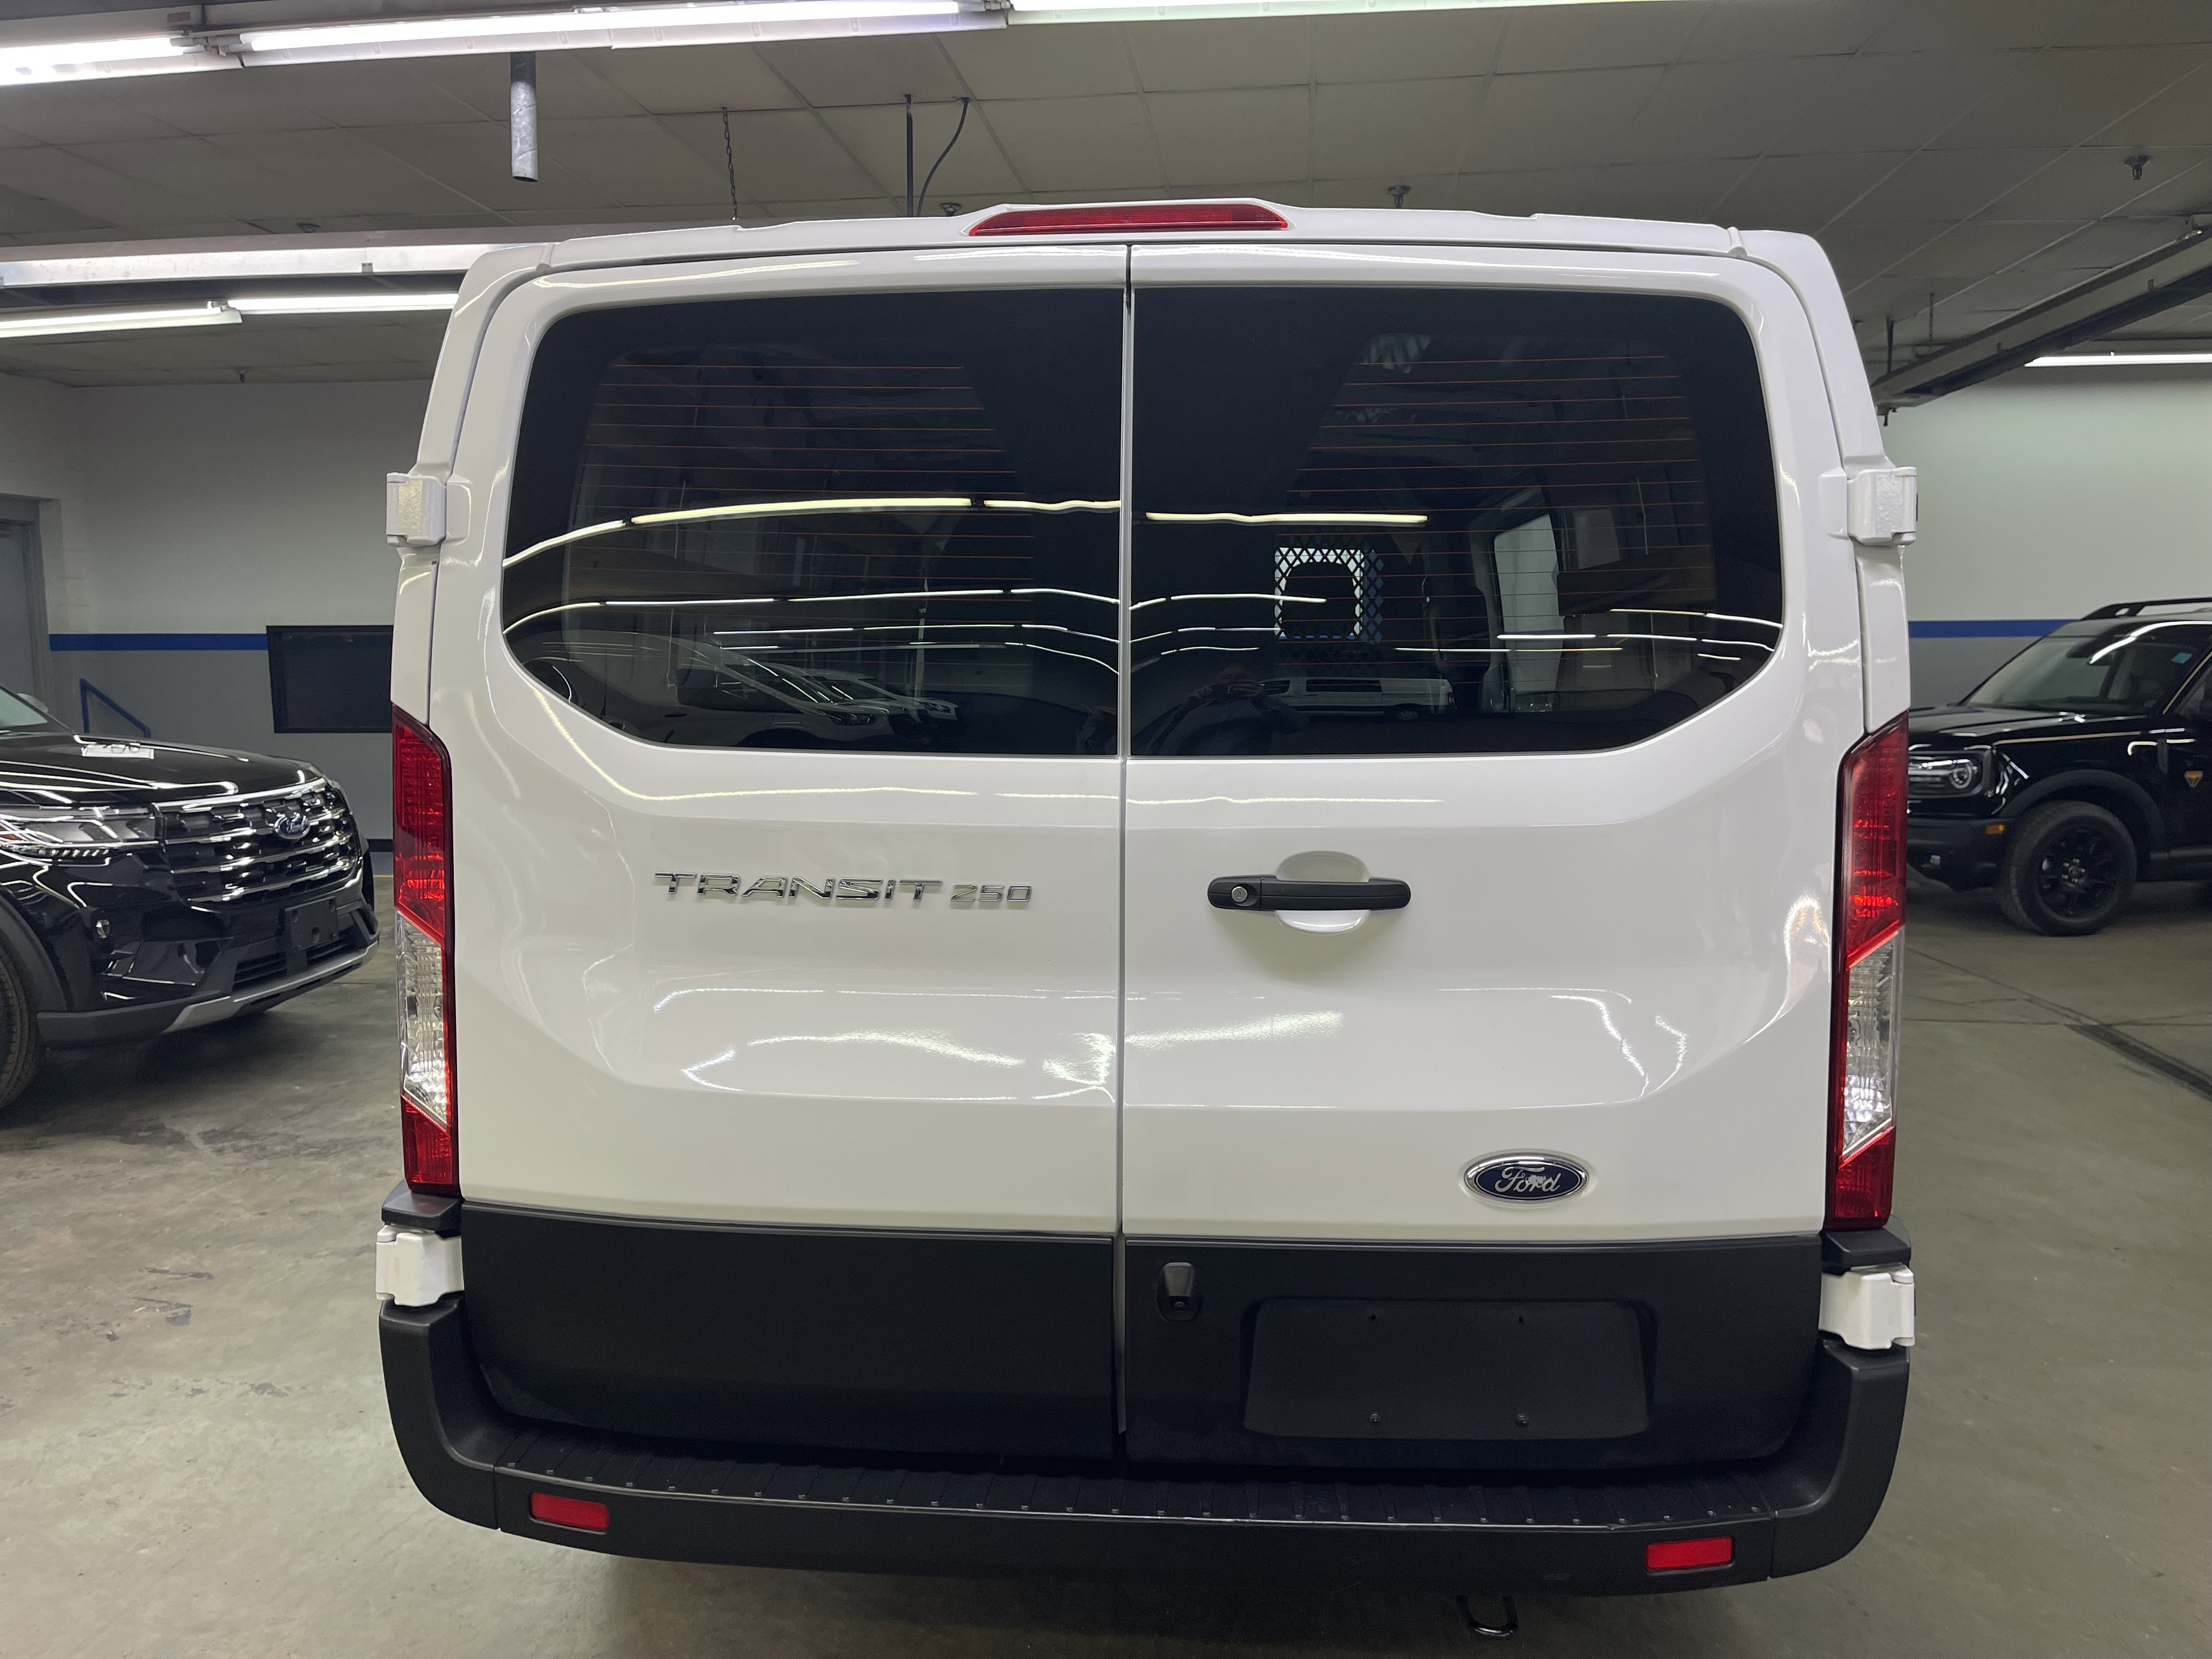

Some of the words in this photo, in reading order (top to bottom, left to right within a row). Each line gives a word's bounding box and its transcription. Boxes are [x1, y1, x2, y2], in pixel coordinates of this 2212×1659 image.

[286, 814, 307, 834] Ford
[654, 872, 943, 901] TRANSIT
[951, 884, 1032, 902] 250
[1494, 1166, 1561, 1193] Ford
